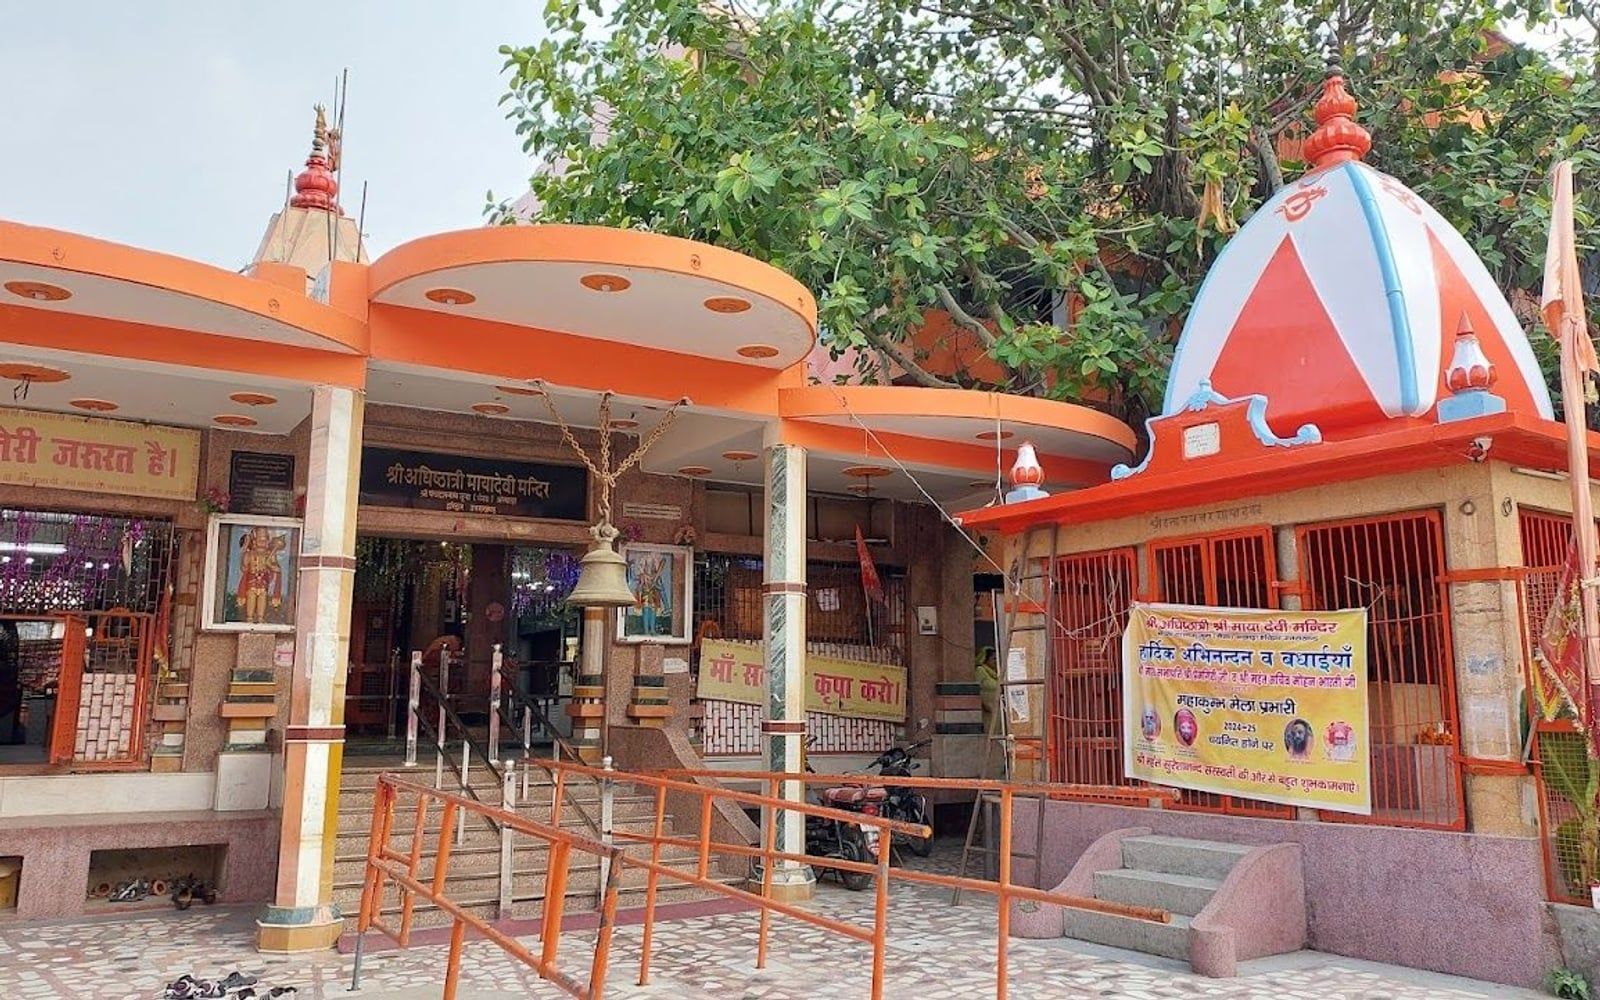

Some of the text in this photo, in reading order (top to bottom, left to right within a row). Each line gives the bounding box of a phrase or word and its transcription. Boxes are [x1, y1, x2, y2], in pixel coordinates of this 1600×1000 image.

[386, 463, 405, 484] श्री
[404, 465, 465, 490] अधिष्ठात्री
[518, 476, 551, 498] मन्दिर
[1213, 619, 1227, 631] श्री
[1231, 621, 1260, 633] माया
[1264, 620, 1288, 633] देवी
[1292, 619, 1338, 633] मन्दिर
[1139, 640, 1175, 660] हार्दिक
[1181, 643, 1254, 665] अभिनन्दन
[1260, 651, 1273, 666] व
[814, 672, 854, 705] कृपा
[1229, 695, 1256, 712] मेला
[1259, 698, 1296, 714] प्रभारी
[1224, 721, 1256, 733] 2024-25
[1262, 740, 1275, 751] पर
